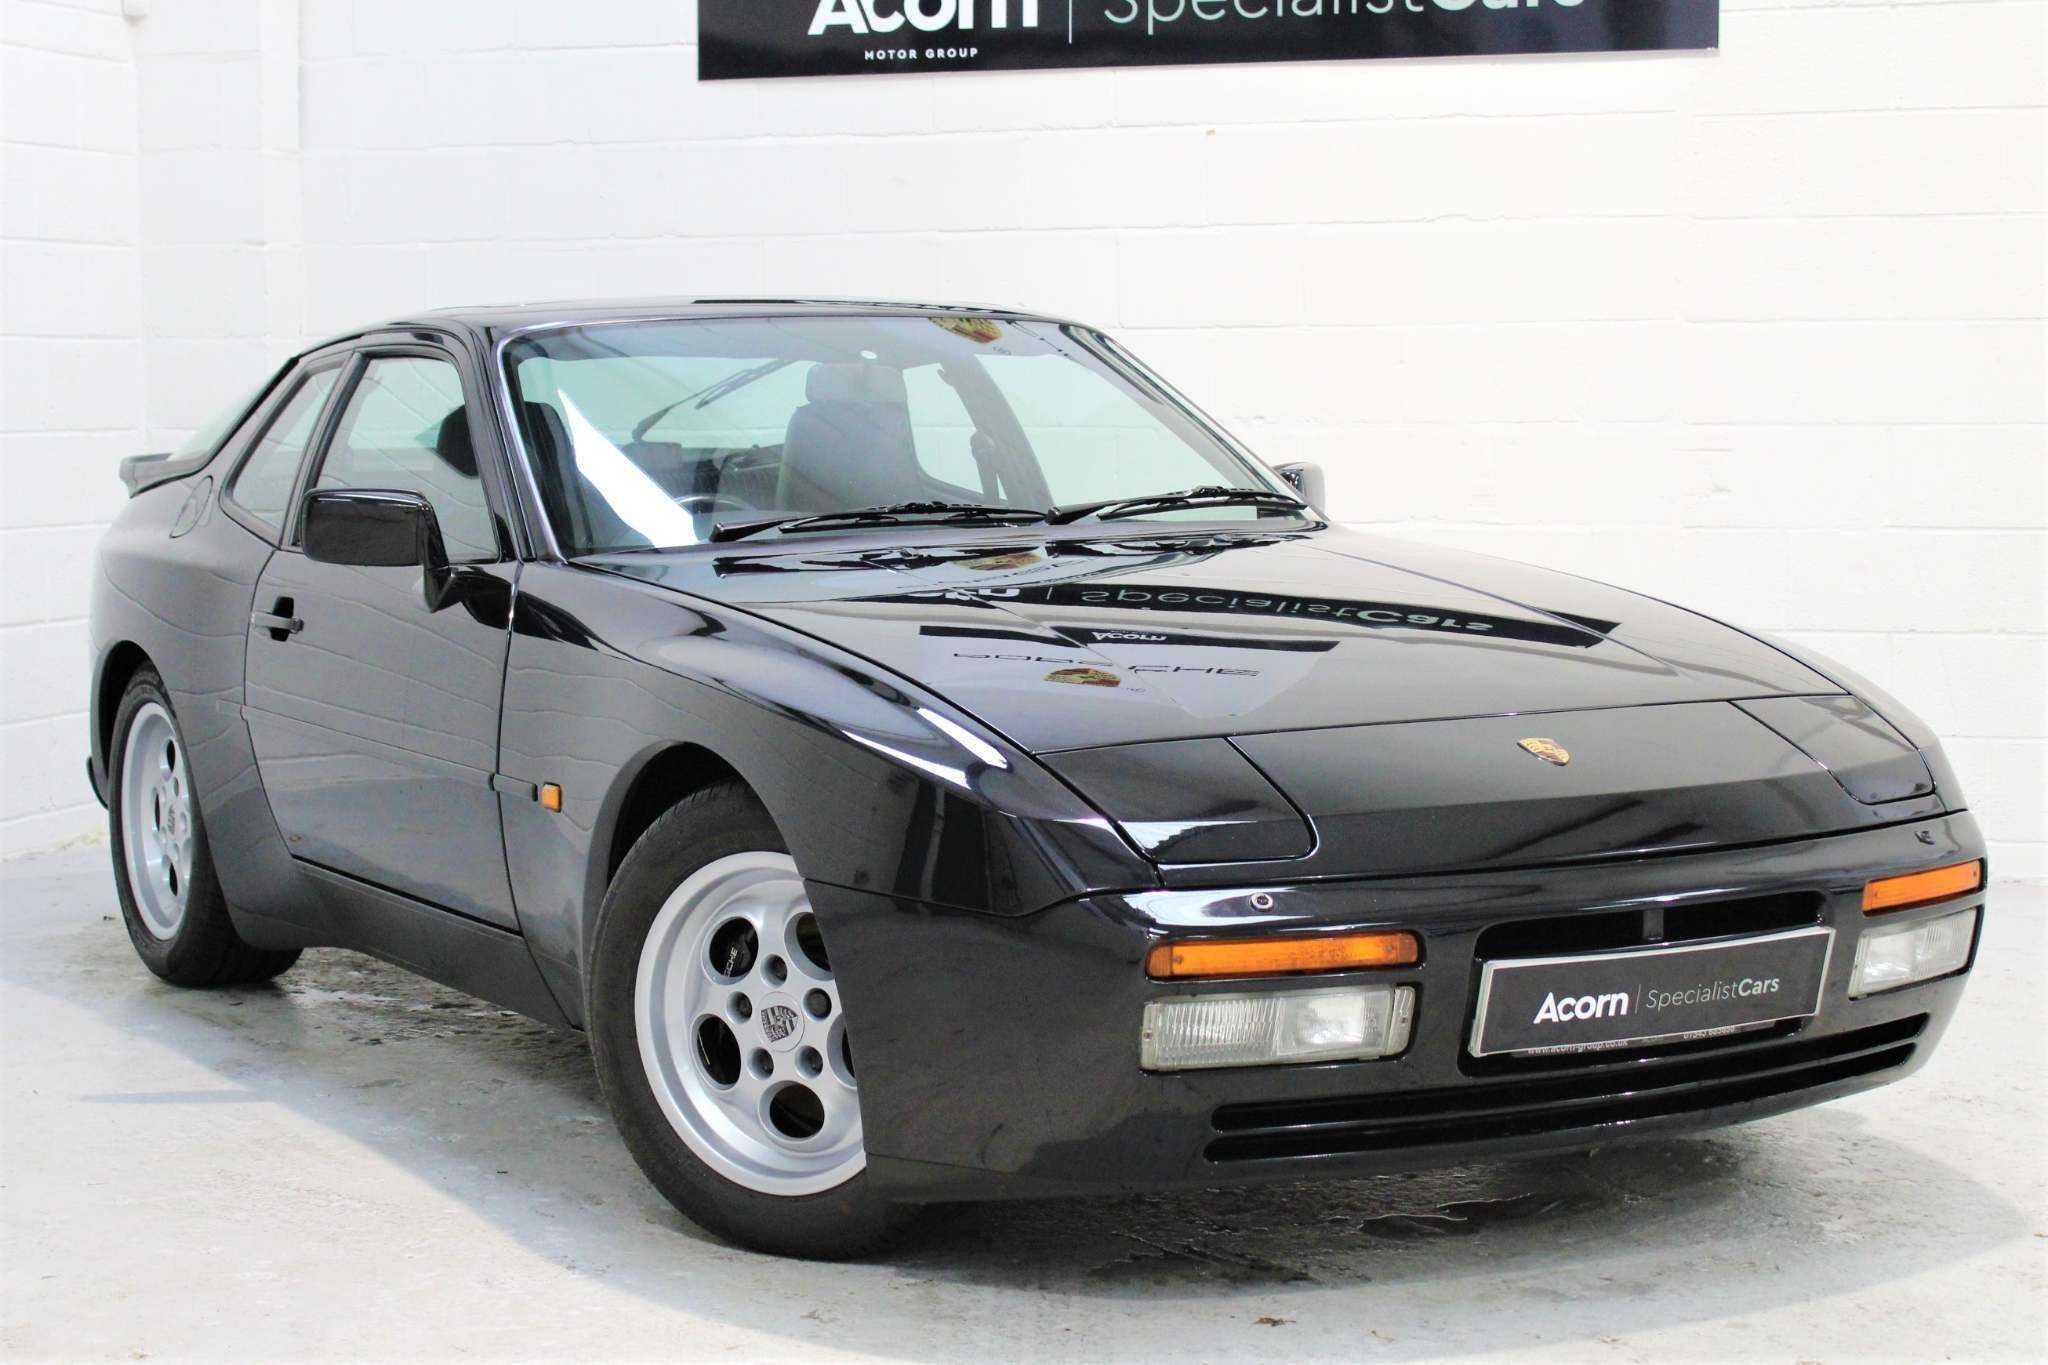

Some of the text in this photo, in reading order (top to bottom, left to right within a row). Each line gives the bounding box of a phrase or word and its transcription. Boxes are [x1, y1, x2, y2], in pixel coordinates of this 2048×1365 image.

[864, 48, 979, 60] MOTOR GROUP
[1533, 978, 1780, 1024] Acorn SpecialistCars
